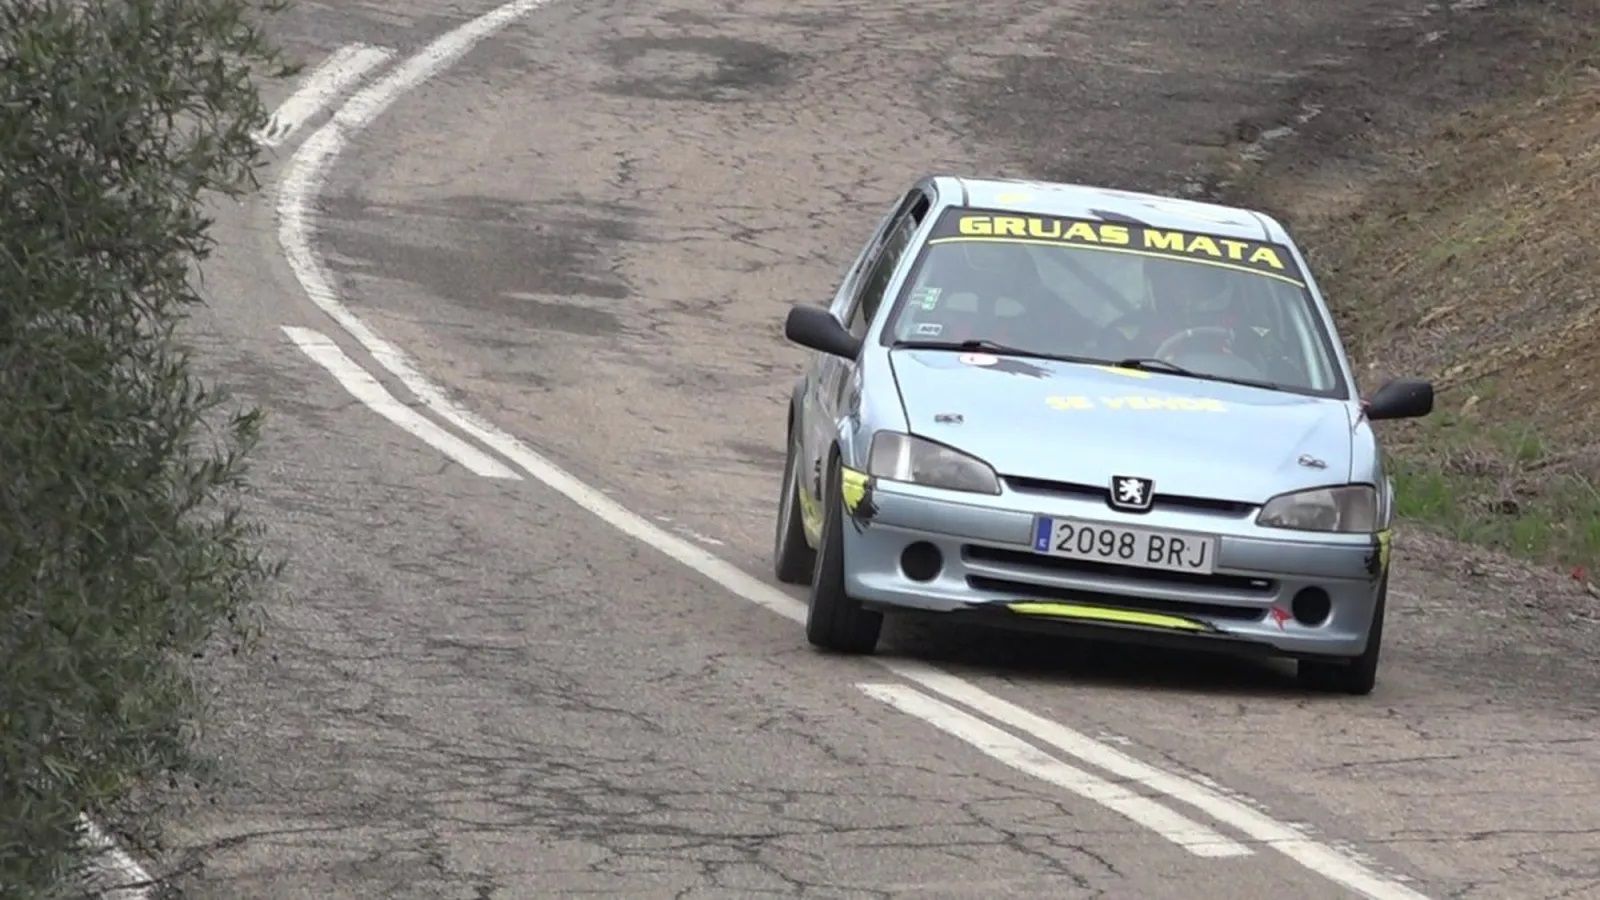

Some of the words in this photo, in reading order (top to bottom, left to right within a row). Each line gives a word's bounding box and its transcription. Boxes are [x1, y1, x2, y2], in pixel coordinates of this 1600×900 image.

[959, 217, 1129, 245] GRUAS
[1145, 230, 1285, 269] MATA
[1056, 524, 1136, 559] 2098
[1147, 535, 1206, 568] BRJ
